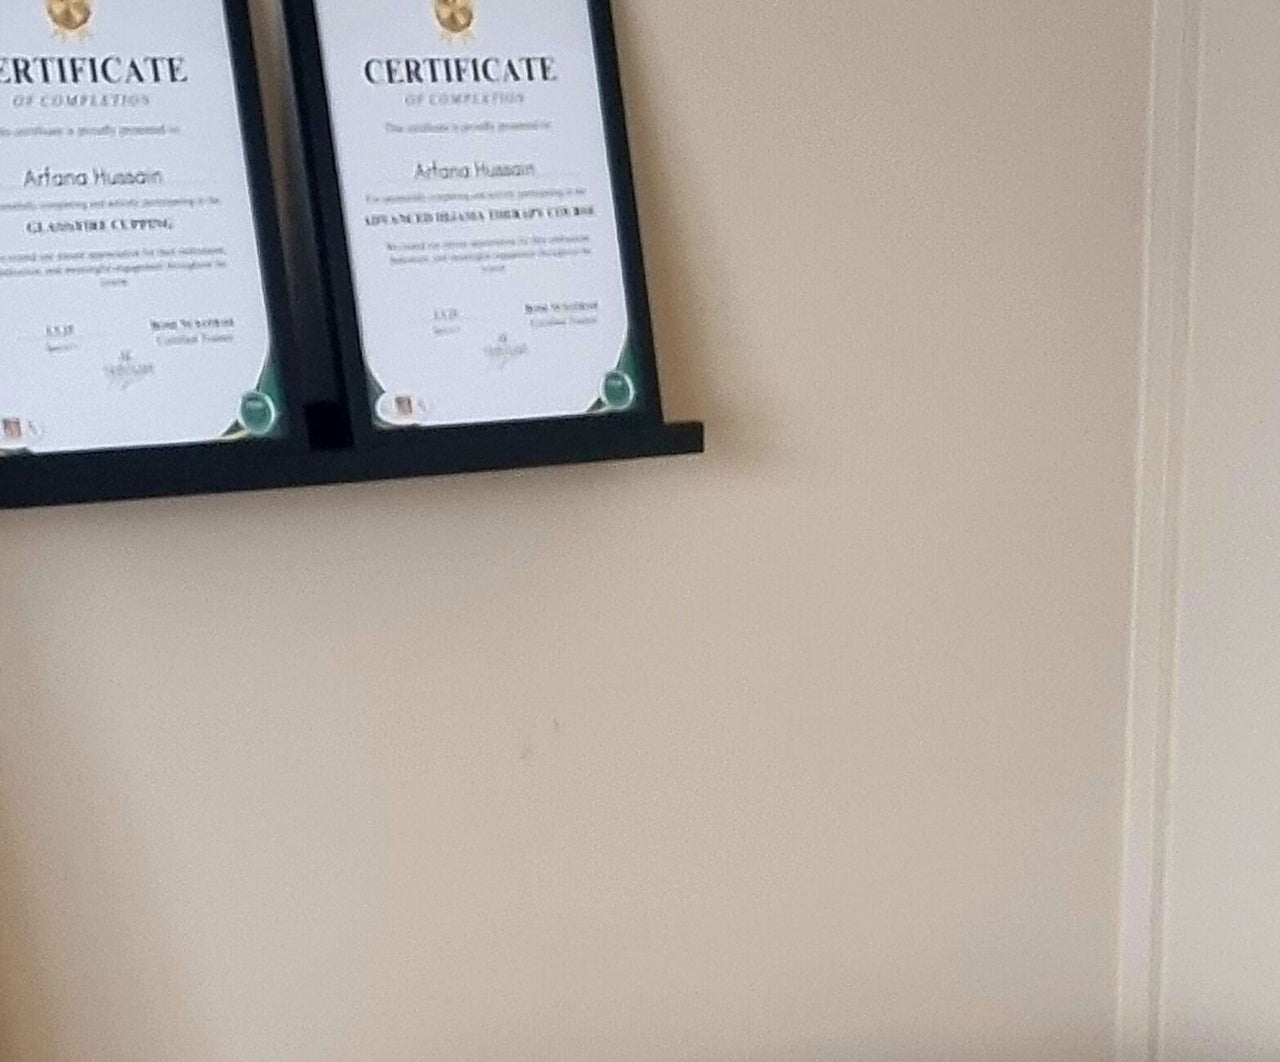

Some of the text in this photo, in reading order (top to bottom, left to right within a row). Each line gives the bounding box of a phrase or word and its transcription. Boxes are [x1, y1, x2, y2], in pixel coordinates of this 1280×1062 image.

[364, 56, 557, 84] CERTIFICATE
[12, 94, 33, 108] OF
[23, 165, 163, 189] Arfana Hussain
